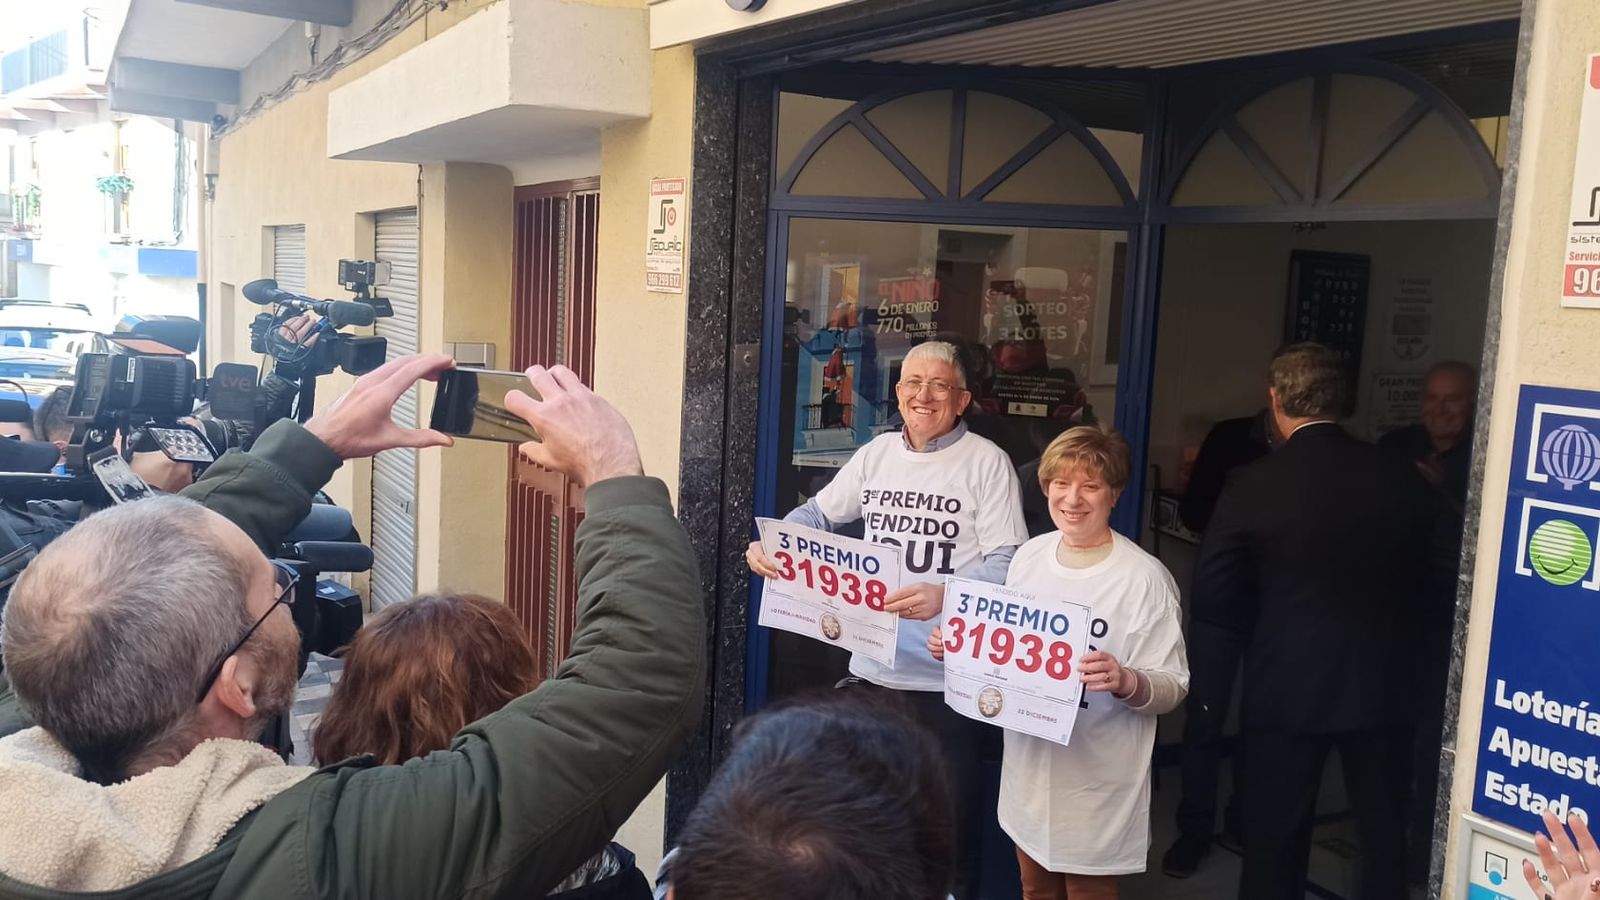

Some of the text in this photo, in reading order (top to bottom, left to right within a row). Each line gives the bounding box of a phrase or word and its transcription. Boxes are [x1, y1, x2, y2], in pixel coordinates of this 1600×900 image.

[877, 299, 939, 316] 6 DE ENERO
[1003, 302, 1067, 317] SORTEO
[876, 317, 904, 335] 770
[1014, 326, 1067, 341] LOTES
[219, 374, 251, 392] tve
[880, 490, 961, 514] PREMIO
[866, 511, 960, 539] ENDIDO
[797, 536, 880, 575] PREMIO
[774, 551, 888, 612] 31938
[975, 597, 1070, 636] PREMIO
[944, 616, 1073, 681] 31938
[1025, 711, 1057, 724] DICIEMBRE
